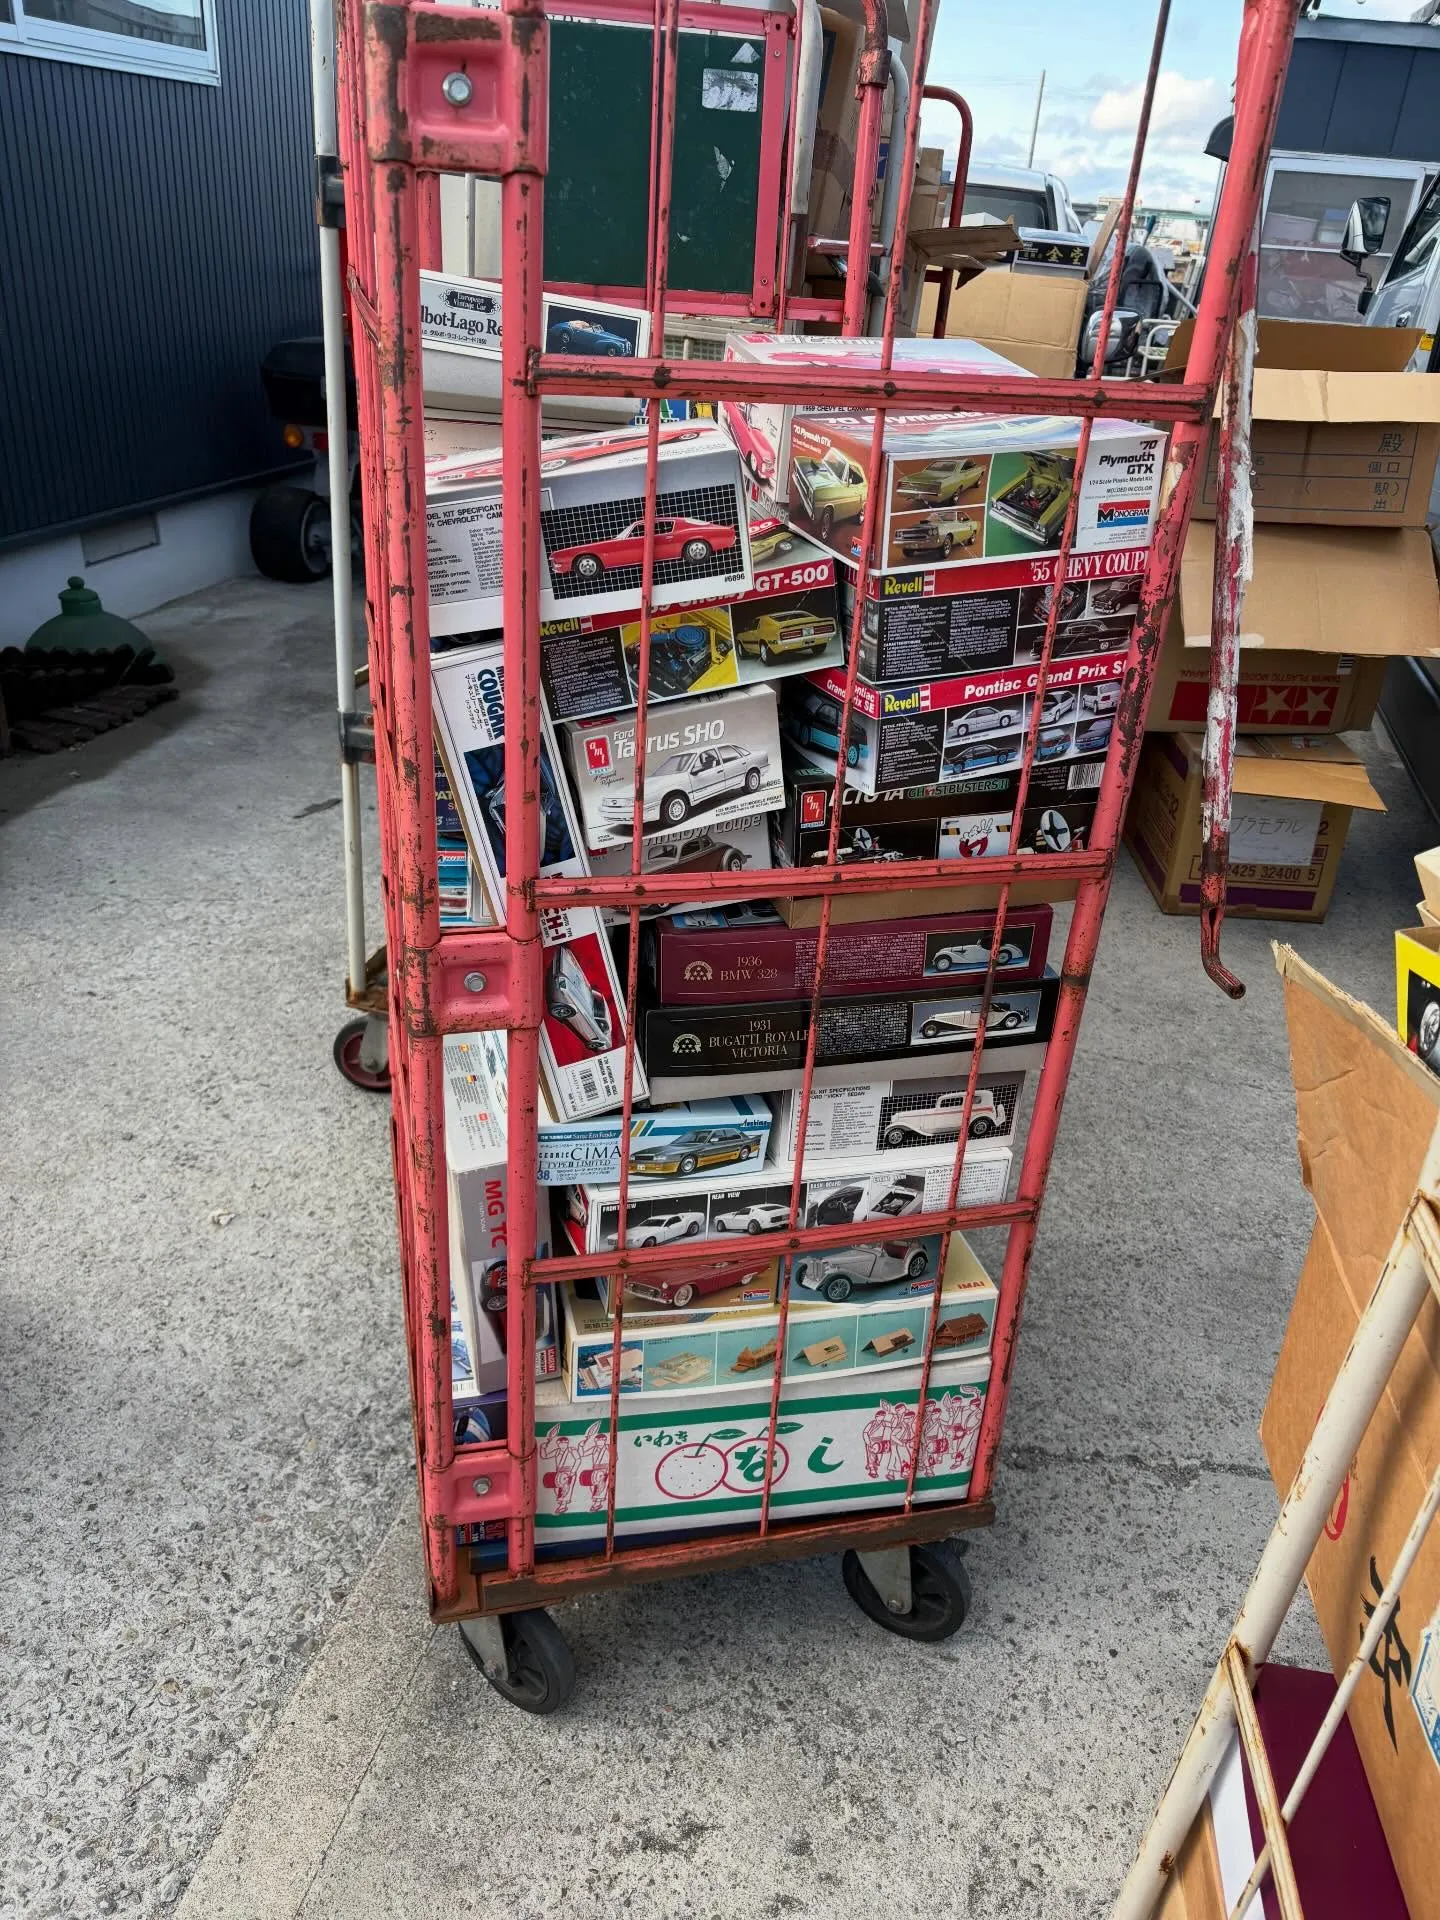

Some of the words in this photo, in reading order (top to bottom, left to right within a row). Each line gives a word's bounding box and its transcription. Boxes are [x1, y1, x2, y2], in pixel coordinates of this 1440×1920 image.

[1141, 440, 1158, 450] '70
[1378, 433, 1404, 453] 殿
[1099, 452, 1155, 467] Plymouth
[1127, 464, 1154, 474] GTX
[725, 573, 745, 582] #6896
[756, 564, 829, 591] GT-500
[884, 576, 922, 595] Revell
[541, 617, 579, 636] Revell
[965, 678, 1021, 699] Pontiac
[1027, 666, 1073, 687] Gand
[1078, 664, 1107, 679] Prix
[826, 680, 846, 698] Grand
[864, 700, 875, 713] SE
[884, 693, 919, 712] Revell
[613, 728, 635, 740] Ford
[615, 732, 680, 759] Tarus
[684, 719, 725, 748] SHO
[1231, 815, 1303, 835] プラモデル
[1261, 866, 1300, 880] 32400
[1308, 870, 1316, 880] 5
[737, 956, 762, 967] 1936
[720, 969, 753, 981] BMW
[757, 968, 778, 979] 328
[749, 1020, 772, 1032] 1931
[709, 1033, 759, 1048] BUGATTI
[732, 1045, 788, 1059] VICTORIA
[571, 1145, 621, 1160] CIMA
[485, 1180, 504, 1216] MG
[728, 1191, 741, 1199] VIEW
[490, 1222, 508, 1248] TC
[634, 1430, 688, 1447] いわき
